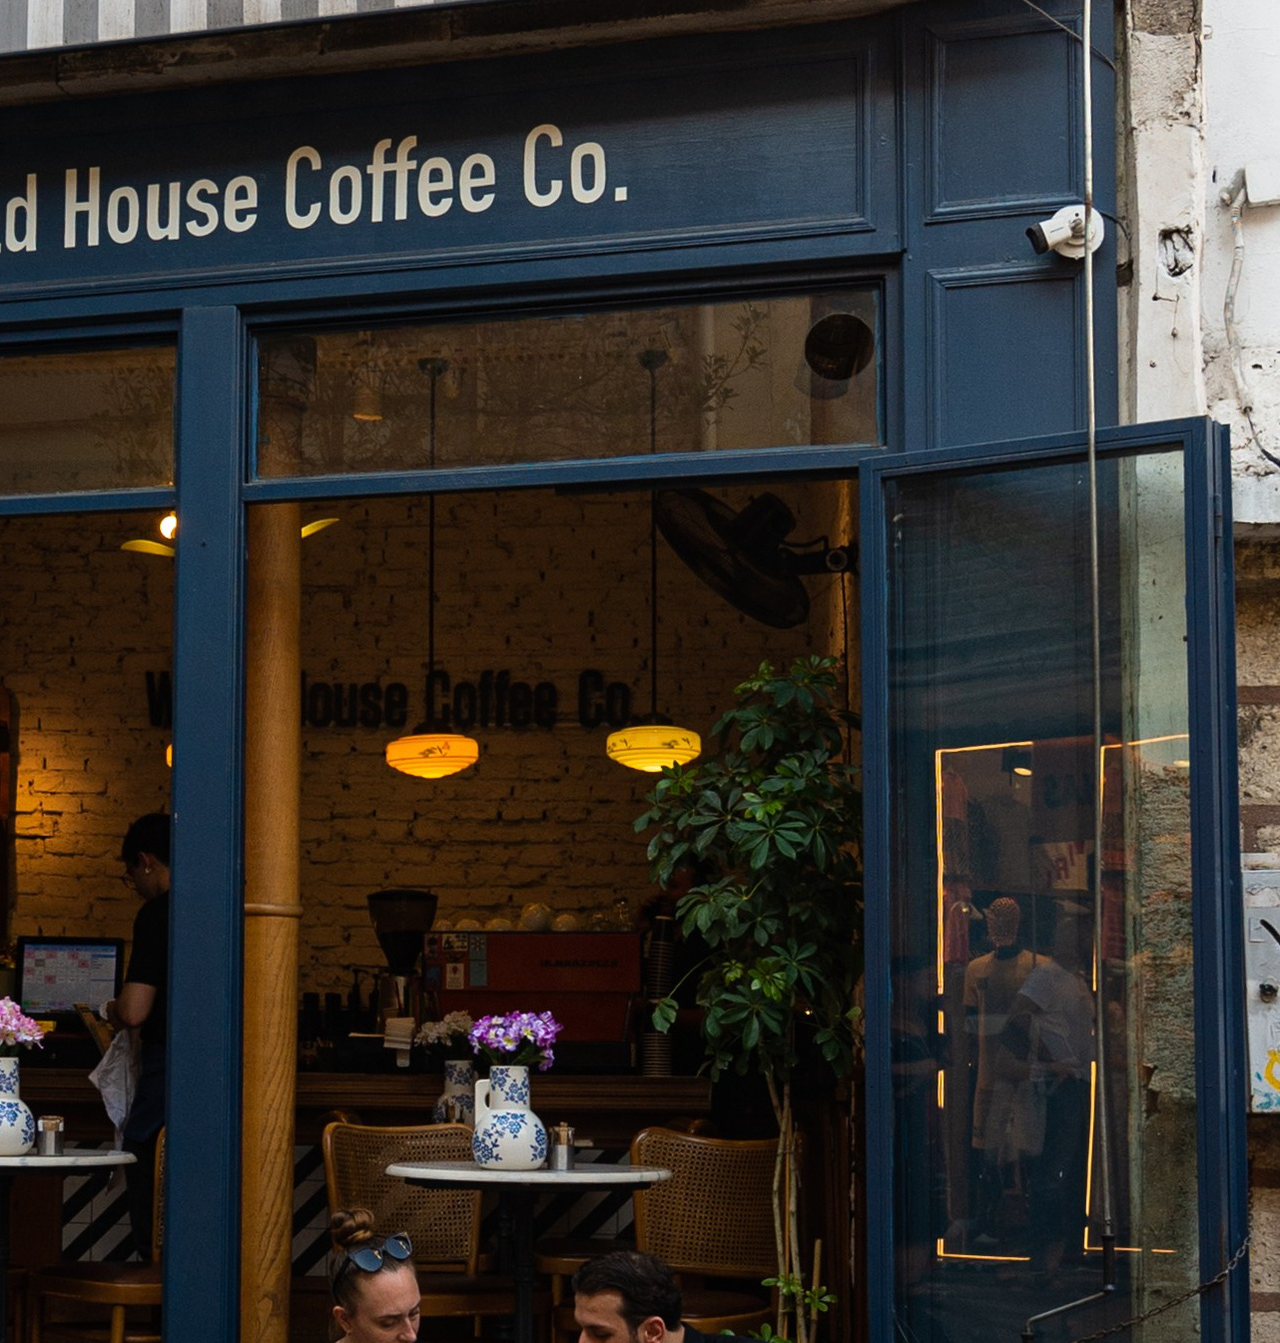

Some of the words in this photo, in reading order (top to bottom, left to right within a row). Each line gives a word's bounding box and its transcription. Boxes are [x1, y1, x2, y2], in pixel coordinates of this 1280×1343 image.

[63, 166, 258, 249] House
[284, 135, 496, 230] Coffee
[523, 124, 629, 207] Co.
[427, 669, 557, 727] Coffee
